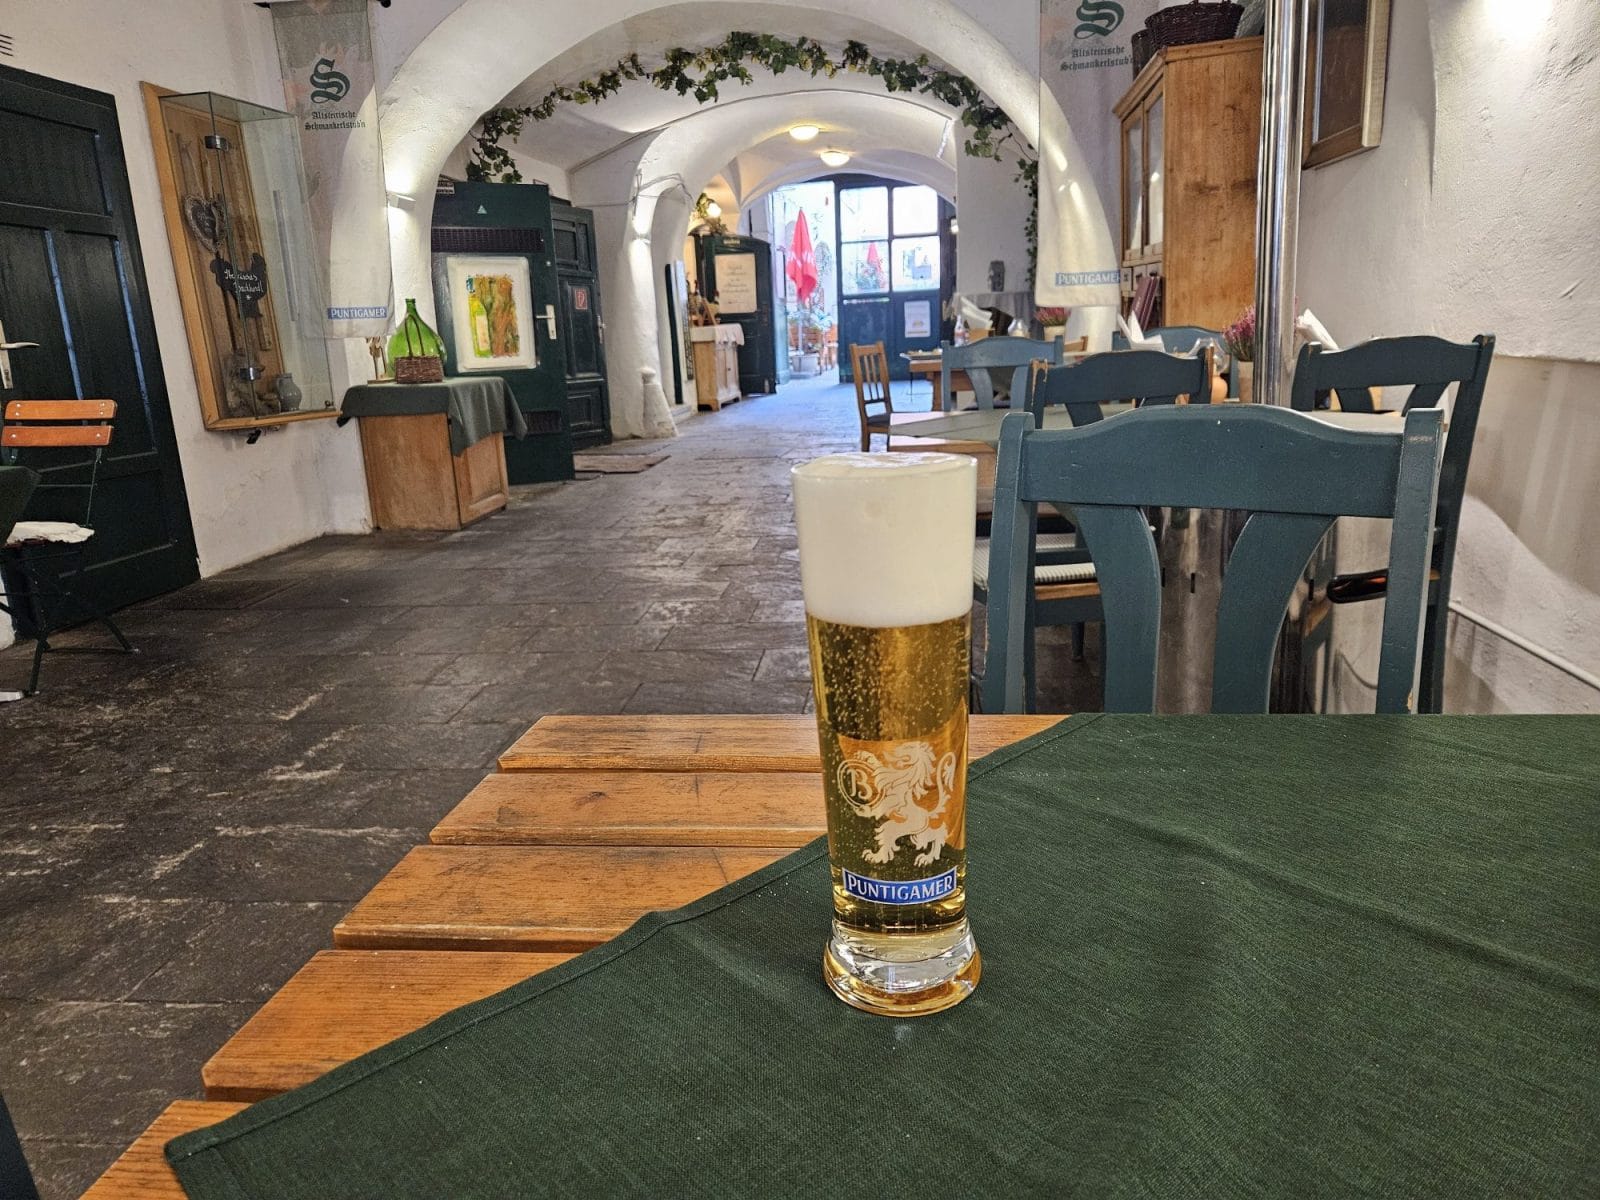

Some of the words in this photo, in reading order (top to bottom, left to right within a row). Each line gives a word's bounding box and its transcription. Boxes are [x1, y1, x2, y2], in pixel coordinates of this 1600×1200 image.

[1073, 0, 1124, 39] S
[309, 57, 350, 103] S
[331, 308, 386, 318] PUNTIGAMER
[847, 874, 953, 901] PUNTIGAMER
